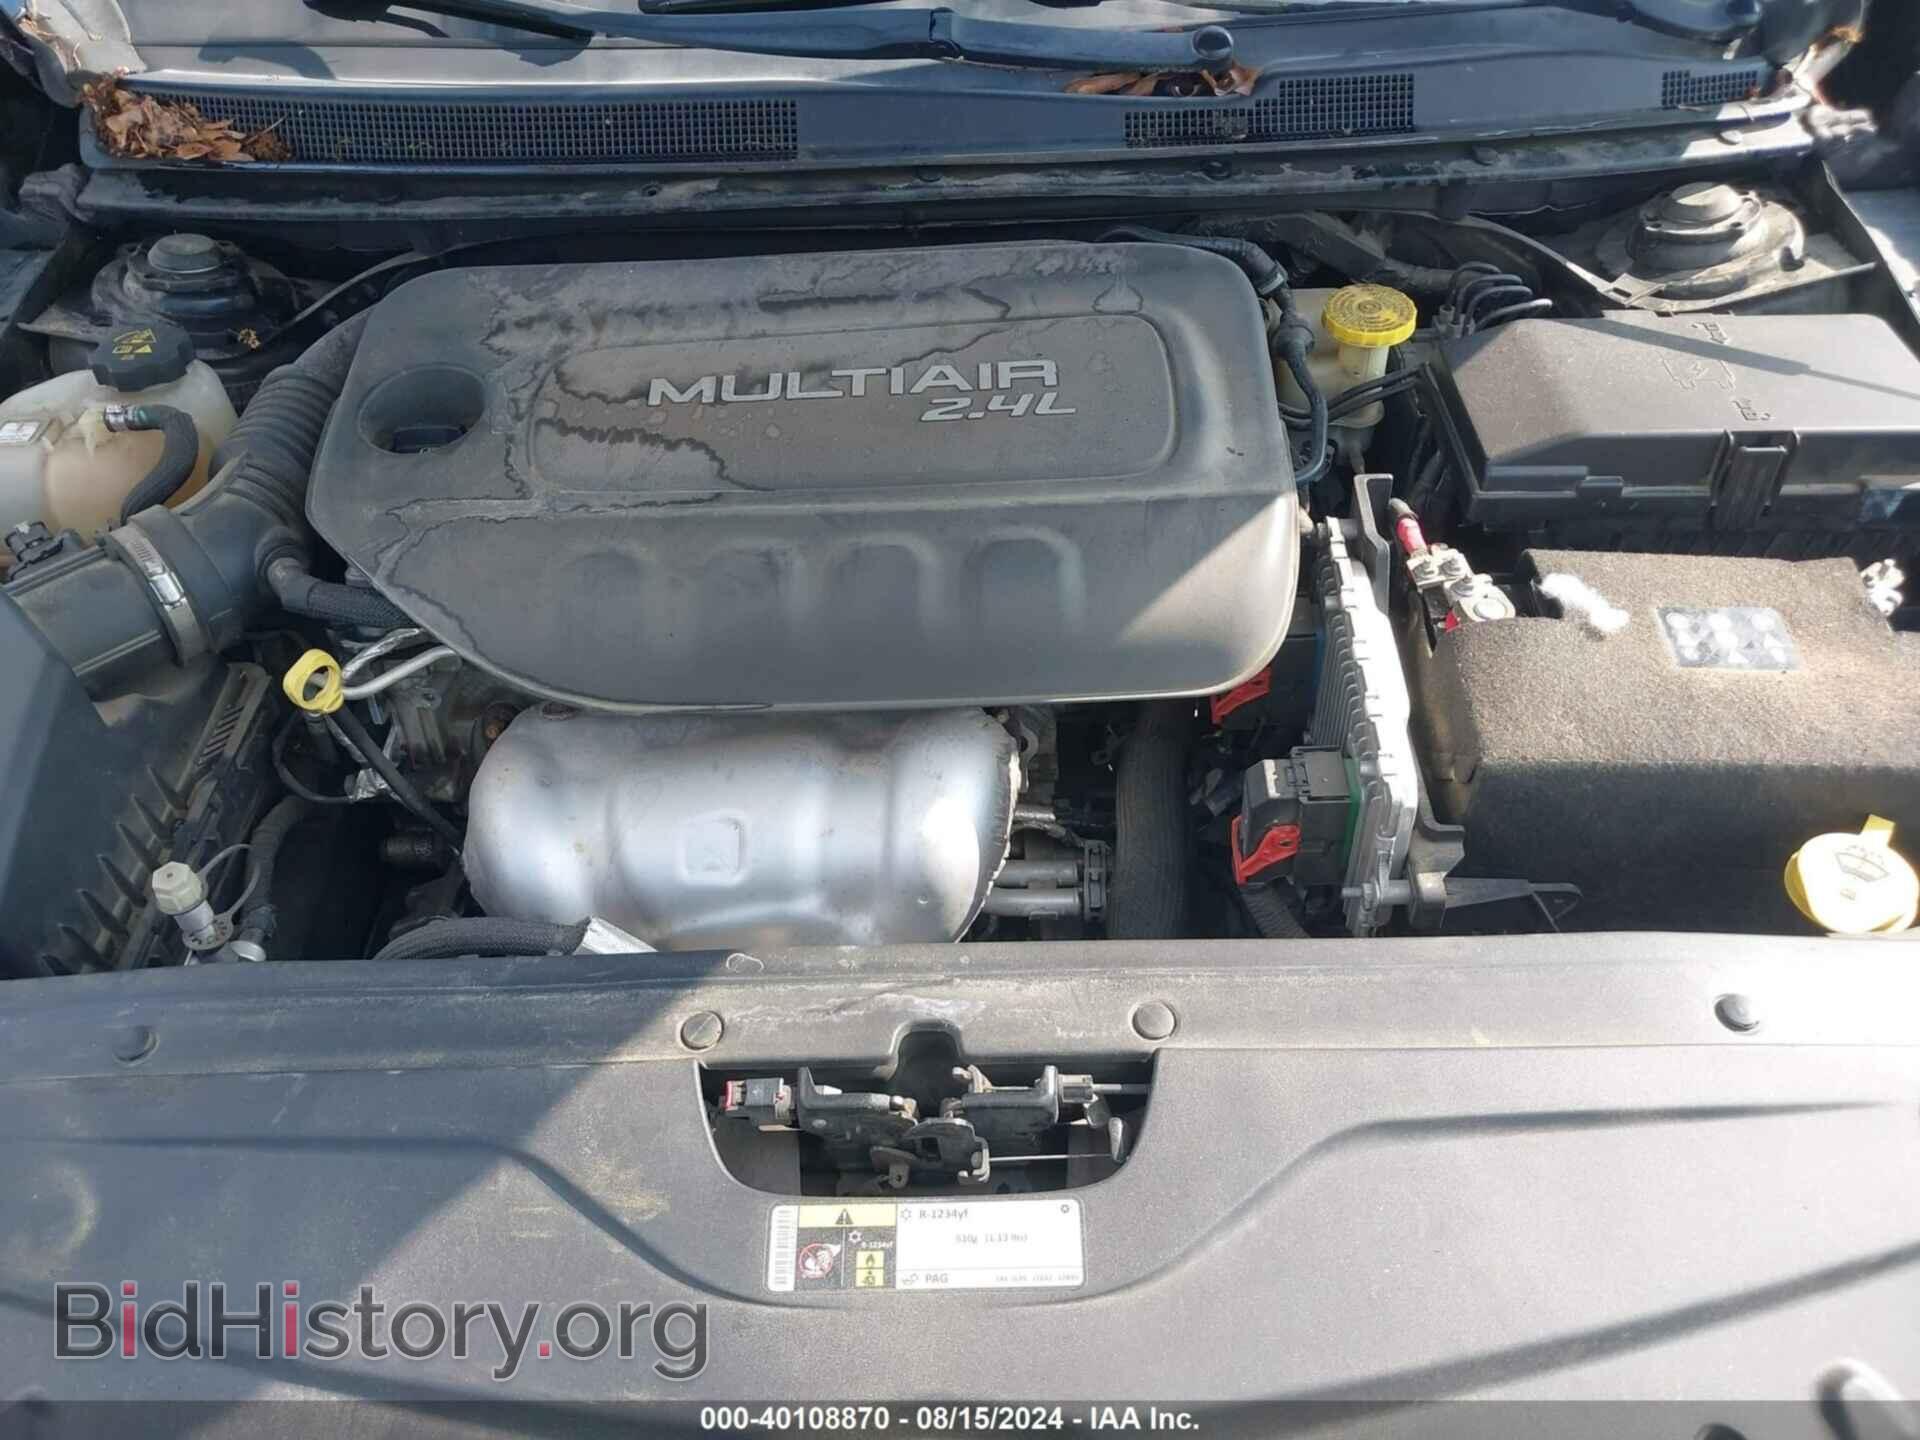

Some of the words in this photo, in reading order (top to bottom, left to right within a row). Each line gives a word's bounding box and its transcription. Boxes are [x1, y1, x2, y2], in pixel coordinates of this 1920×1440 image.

[648, 359, 1058, 405] MULTIAIR
[920, 392, 1076, 422] 2.4L
[918, 1208, 969, 1221] R-1234yf
[925, 1273, 949, 1284] PAG
